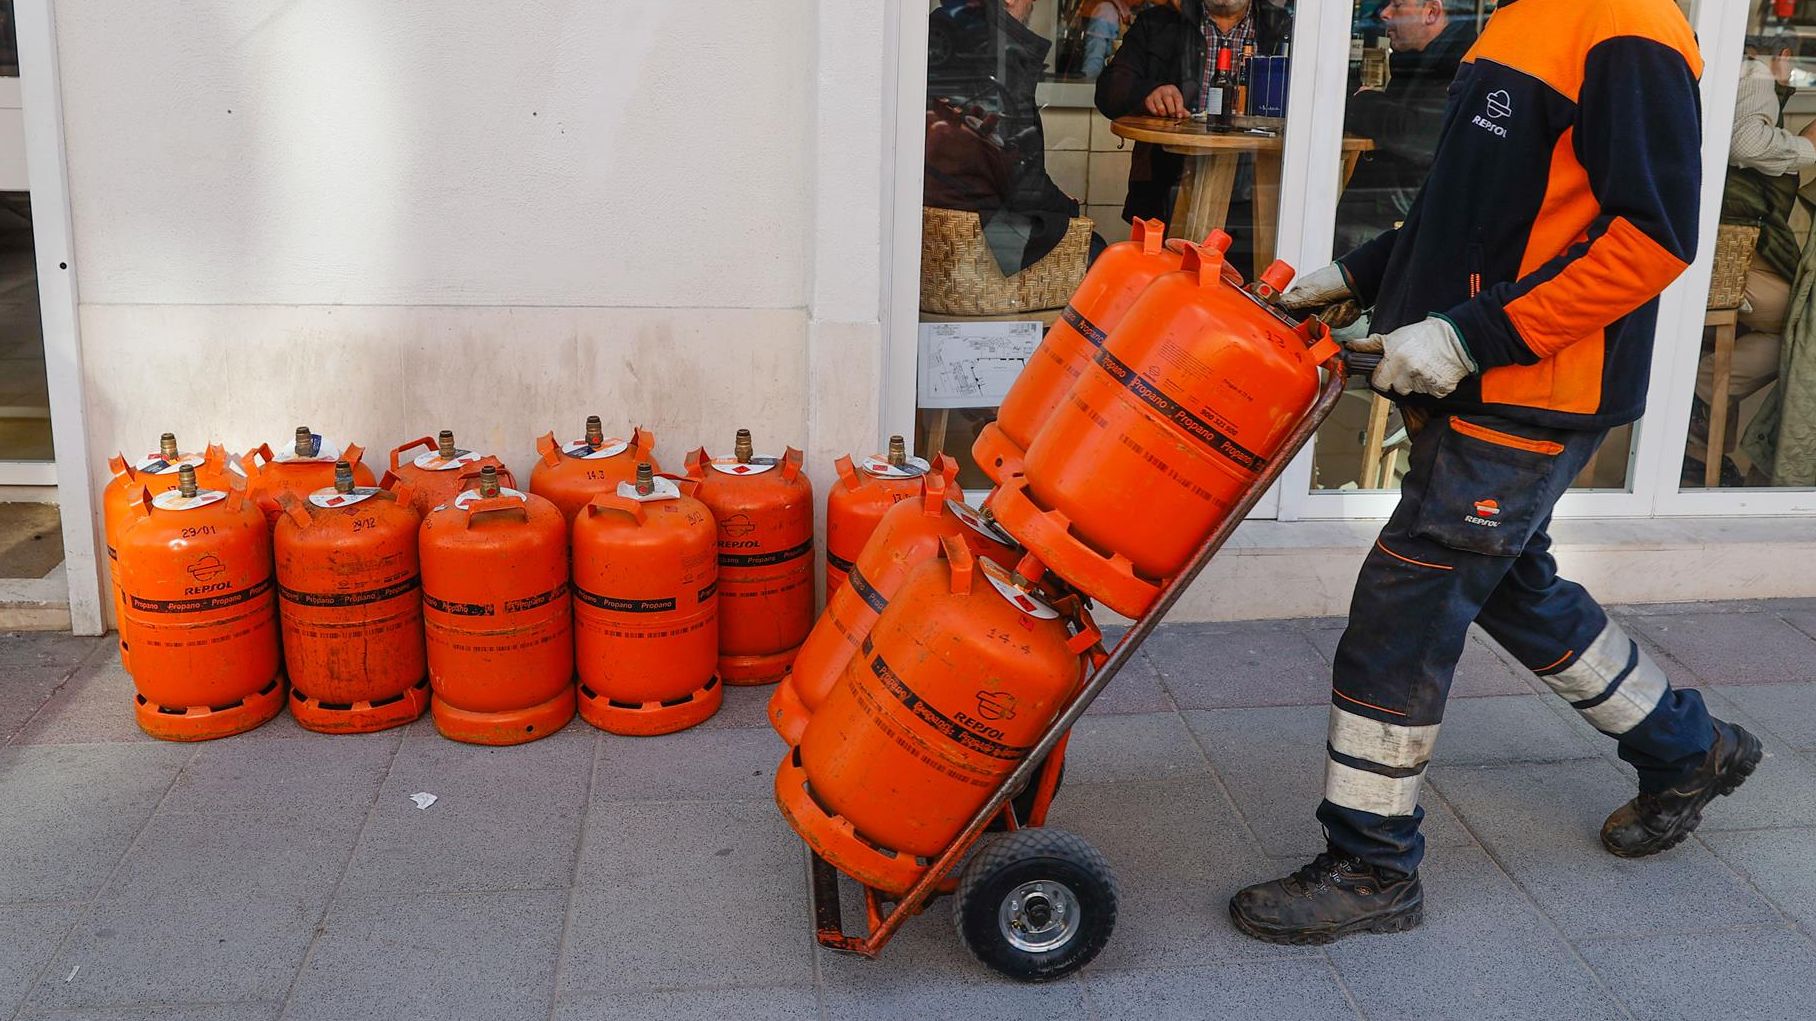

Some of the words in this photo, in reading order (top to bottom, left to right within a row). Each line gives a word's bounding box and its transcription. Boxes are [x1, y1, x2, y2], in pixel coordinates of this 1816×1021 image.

[1472, 115, 1507, 138] REPSOL
[1127, 374, 1168, 409] Propano
[1175, 410, 1215, 440] Propano
[1465, 515, 1499, 527] REPSOL
[718, 540, 761, 549] REPSOL
[184, 580, 233, 596] REPSOL
[134, 599, 159, 611] Propano
[167, 602, 200, 611] Propano
[211, 595, 242, 607] Propano
[306, 595, 335, 605] Propano
[344, 593, 376, 604] Propano
[603, 599, 633, 610] Propano
[641, 601, 673, 610] Propano
[880, 666, 908, 699] Propano
[953, 711, 1006, 741] REPSOL
